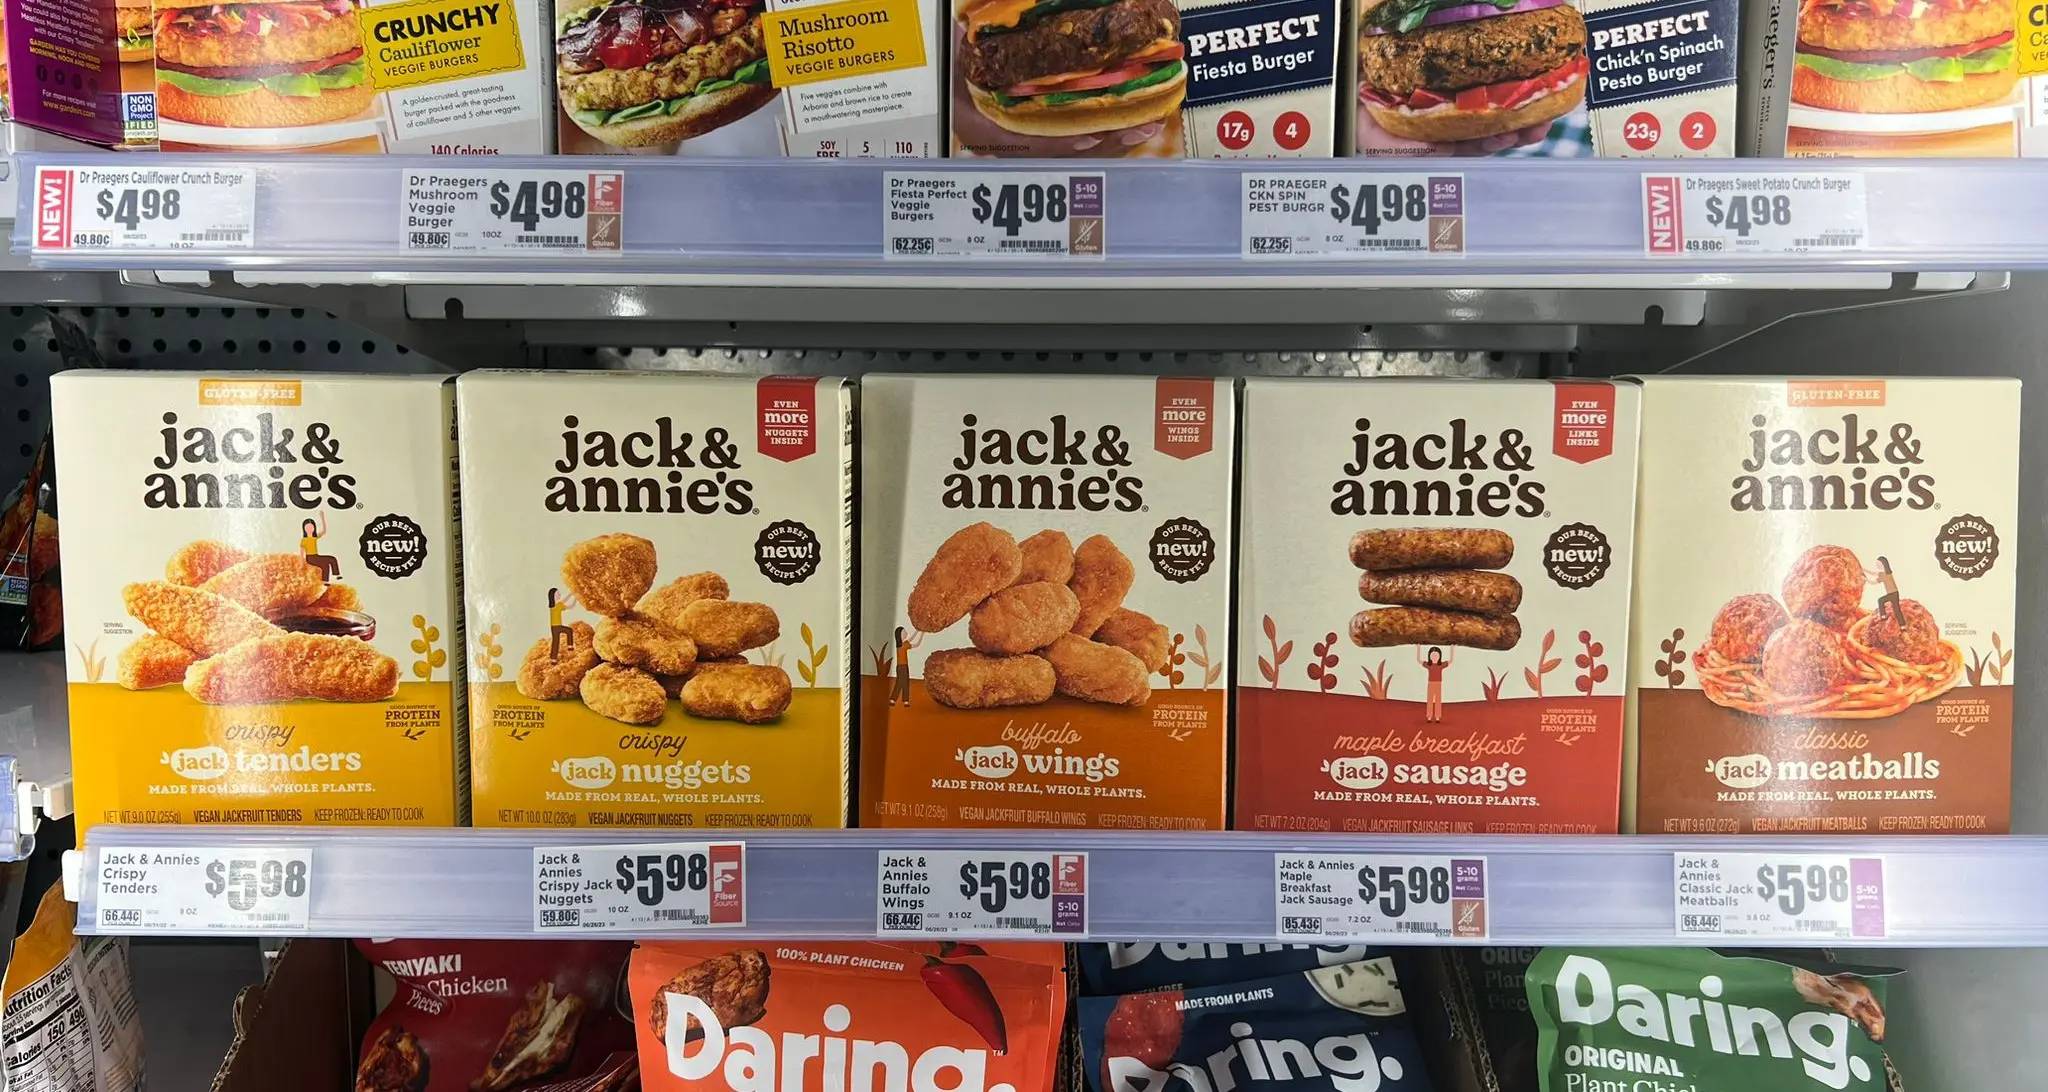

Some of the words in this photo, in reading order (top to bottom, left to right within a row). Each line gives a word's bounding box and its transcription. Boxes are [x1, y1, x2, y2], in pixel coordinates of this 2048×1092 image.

[373, 3, 499, 43] CRUNCHY
[779, 8, 889, 37] Mushroom
[1592, 10, 1709, 51] PERFECT
[1188, 14, 1320, 57] PERFECT
[379, 33, 481, 62] Cauliflower
[782, 36, 855, 59] Risotto
[1659, 35, 1724, 63] Spinach
[383, 60, 426, 77] VEGGIE
[429, 54, 479, 69] BURGERS
[786, 57, 835, 76] VEGGIE
[839, 51, 895, 68] BURGERS
[1192, 60, 1247, 81] Fiesta
[1252, 50, 1315, 73] Burger
[1599, 71, 1643, 91] Pesto
[1646, 60, 1703, 85] Burger
[130, 96, 152, 104] NON
[130, 104, 153, 112] GMO
[404, 108, 427, 117] burger
[428, 102, 454, 115] packed
[455, 100, 470, 108] with
[482, 94, 516, 106] goodness
[1222, 122, 1249, 141] 17g
[1286, 122, 1298, 138] 4
[1626, 123, 1657, 143] 23g
[1692, 123, 1704, 139] 2
[79, 171, 90, 184] Dr
[92, 172, 129, 186] Praegers
[131, 171, 179, 184] Cauliflower
[181, 172, 211, 184] Crunch
[214, 172, 242, 186] Burger
[410, 176, 425, 187] Dr
[429, 176, 488, 189] Praegers
[891, 179, 906, 188] Dr
[910, 179, 956, 190] Praegers
[1249, 180, 1266, 189] DR
[1270, 180, 1327, 189] PRAEGER
[1686, 179, 1696, 190] Dr
[1699, 179, 1734, 191] Praegers
[1736, 179, 1761, 190] Sweet
[1764, 179, 1790, 190] Potato
[1793, 179, 1821, 190] Crunch
[1823, 179, 1851, 191] Burger
[410, 189, 478, 201] Mushroom
[891, 189, 924, 199] Fiesta
[928, 189, 967, 199] Perfect
[1249, 191, 1275, 201] CKN
[1279, 191, 1306, 201] SPIN
[41, 177, 62, 242] NEW!
[409, 203, 455, 216] Veggie
[891, 201, 930, 211] Veggie
[1249, 203, 1278, 212] PEST
[1282, 203, 1324, 213] BURGR
[409, 216, 453, 229] Burger
[891, 211, 934, 222] Burgers
[1650, 184, 1675, 250] NEW!
[204, 388, 296, 400] GLUTEN-FREE
[1792, 389, 1881, 400] GLUTEN-FREE
[773, 401, 799, 409] EVEN
[764, 412, 809, 425] more
[154, 411, 298, 470] jack
[302, 422, 344, 464] &
[765, 428, 809, 437] NUGGETS
[771, 437, 803, 445] INSIDE
[555, 415, 695, 474] jack
[704, 427, 741, 469] &
[953, 414, 1088, 471] jack
[1092, 425, 1132, 466] &
[1344, 418, 1488, 476] jack
[1494, 429, 1534, 471] &
[1742, 414, 1879, 472] jack
[1884, 423, 1925, 465] &
[144, 466, 356, 509] annie's
[545, 471, 753, 515] annie's
[942, 468, 1143, 512] annie's
[1330, 473, 1546, 517] annie's
[1730, 466, 1936, 512] annie's
[367, 538, 420, 554] new!
[762, 544, 813, 559] new!
[1156, 541, 1207, 557] new!
[1550, 546, 1604, 563] new!
[1942, 537, 1992, 554] new!
[226, 723, 296, 748] crispy
[1001, 719, 1082, 750] buffalo
[1795, 726, 1869, 750] classic
[618, 733, 688, 757] crispy
[1333, 734, 1405, 755] maple
[1409, 729, 1526, 761] breakfast
[176, 750, 226, 771] jack
[236, 746, 361, 772] tenders
[969, 750, 1015, 771] jack
[1023, 748, 1120, 782] wings
[1719, 759, 1768, 781] jack
[1777, 752, 1940, 781] meatballs
[563, 761, 613, 781] jack
[622, 760, 751, 789] nuggets
[1334, 760, 1385, 783] jack
[1393, 762, 1527, 792] sausage
[545, 791, 582, 801] MADE
[586, 792, 621, 802] FROM
[624, 792, 661, 804] REAL,
[663, 792, 708, 803] WHOLE
[712, 793, 764, 804] PLANTS.
[539, 853, 568, 864] Jack
[572, 853, 580, 864] &
[883, 857, 914, 867] Jack
[918, 857, 926, 867] &
[1280, 860, 1302, 869] Jack
[1307, 860, 1315, 870] &
[1318, 861, 1354, 871] Annies
[539, 866, 582, 878] Annies
[883, 870, 928, 881] Annies
[1280, 871, 1312, 883] Maple
[539, 880, 579, 893] Crispy
[583, 878, 613, 890] Jack
[883, 883, 930, 895] Buffalo
[1281, 883, 1331, 893] Breakfast
[539, 893, 593, 907] Nuggets
[883, 897, 925, 909] Wings
[1281, 894, 1305, 904] Jack
[1308, 895, 1353, 907] Sausage
[383, 954, 461, 976] TERIYAKI
[776, 948, 808, 961] 100%
[810, 952, 848, 966] PLANT
[850, 957, 905, 972] CHICKEN
[427, 975, 508, 997] Chicken
[1175, 1000, 1202, 1011] MADE
[1203, 994, 1234, 1007] FROM
[1235, 987, 1275, 1005] PLANTS
[1555, 954, 1871, 1089] Daring.
[665, 990, 1017, 1092] Daring.
[1564, 1044, 1684, 1077] ORIGINAL
